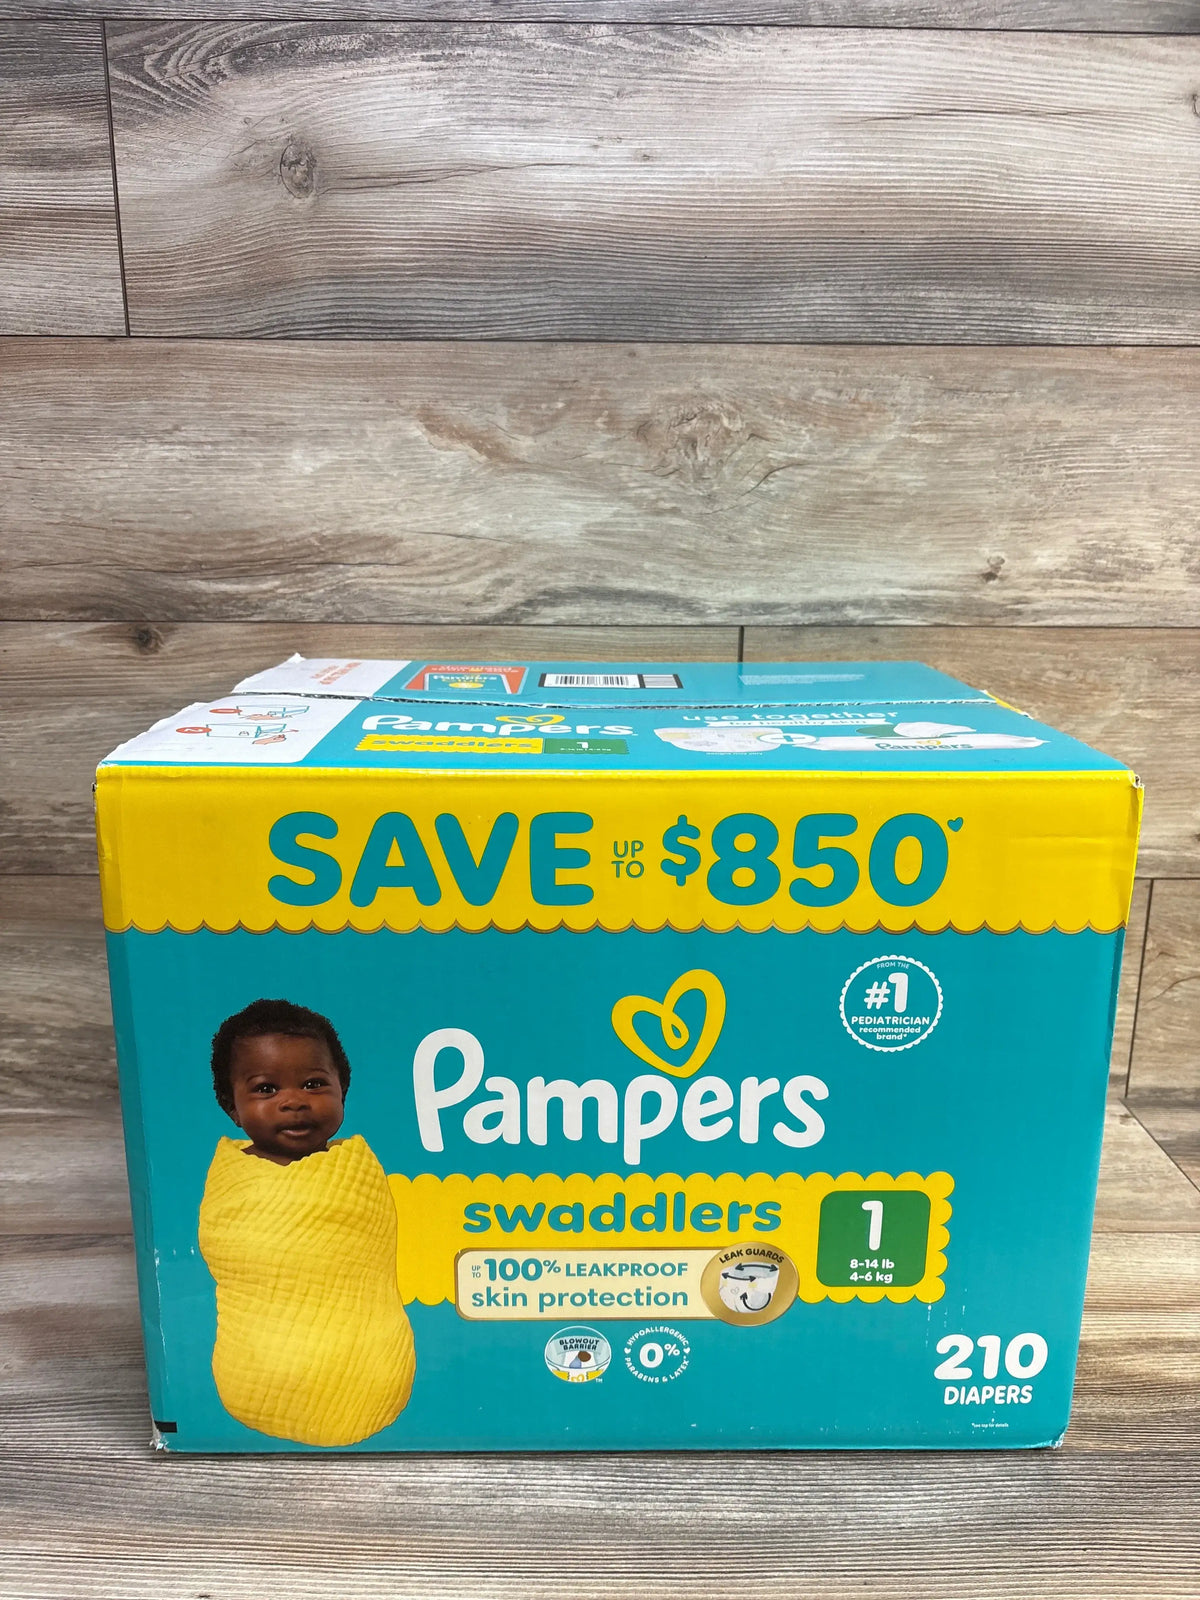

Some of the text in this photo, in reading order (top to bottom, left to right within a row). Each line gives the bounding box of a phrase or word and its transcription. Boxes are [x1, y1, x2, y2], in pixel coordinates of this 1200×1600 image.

[361, 714, 634, 736] Pampers
[751, 711, 899, 721] together
[372, 739, 533, 749] swaddlers
[576, 741, 589, 749] 1
[874, 742, 973, 750] Pampers
[613, 840, 644, 858] UP
[267, 811, 594, 907] SAVE
[660, 812, 949, 907] $850
[611, 860, 645, 878] TO
[876, 961, 910, 970] FROM THE
[863, 972, 909, 1013] #1
[851, 1016, 930, 1025] PEDIATRICIAN
[859, 1026, 921, 1034] recommended
[412, 1028, 830, 1166] Pampers
[463, 1191, 782, 1234] swaddlers
[861, 1200, 884, 1251] 1
[719, 1248, 785, 1264] LEAK GUARDS
[849, 1258, 895, 1269] 8-14 lb
[484, 1258, 689, 1282] 100% LEAKPROOF
[849, 1271, 893, 1284] 4-6 kg
[471, 1286, 689, 1313] skin protection
[559, 1338, 600, 1346] BLOWOUT
[627, 1326, 690, 1346] HYPOALLERGENIC
[563, 1343, 597, 1351] BARRIER
[639, 1342, 680, 1369] 0%
[933, 1332, 1049, 1380] 210
[624, 1357, 660, 1384] PARABENS
[943, 1384, 1034, 1405] DIAPERS
